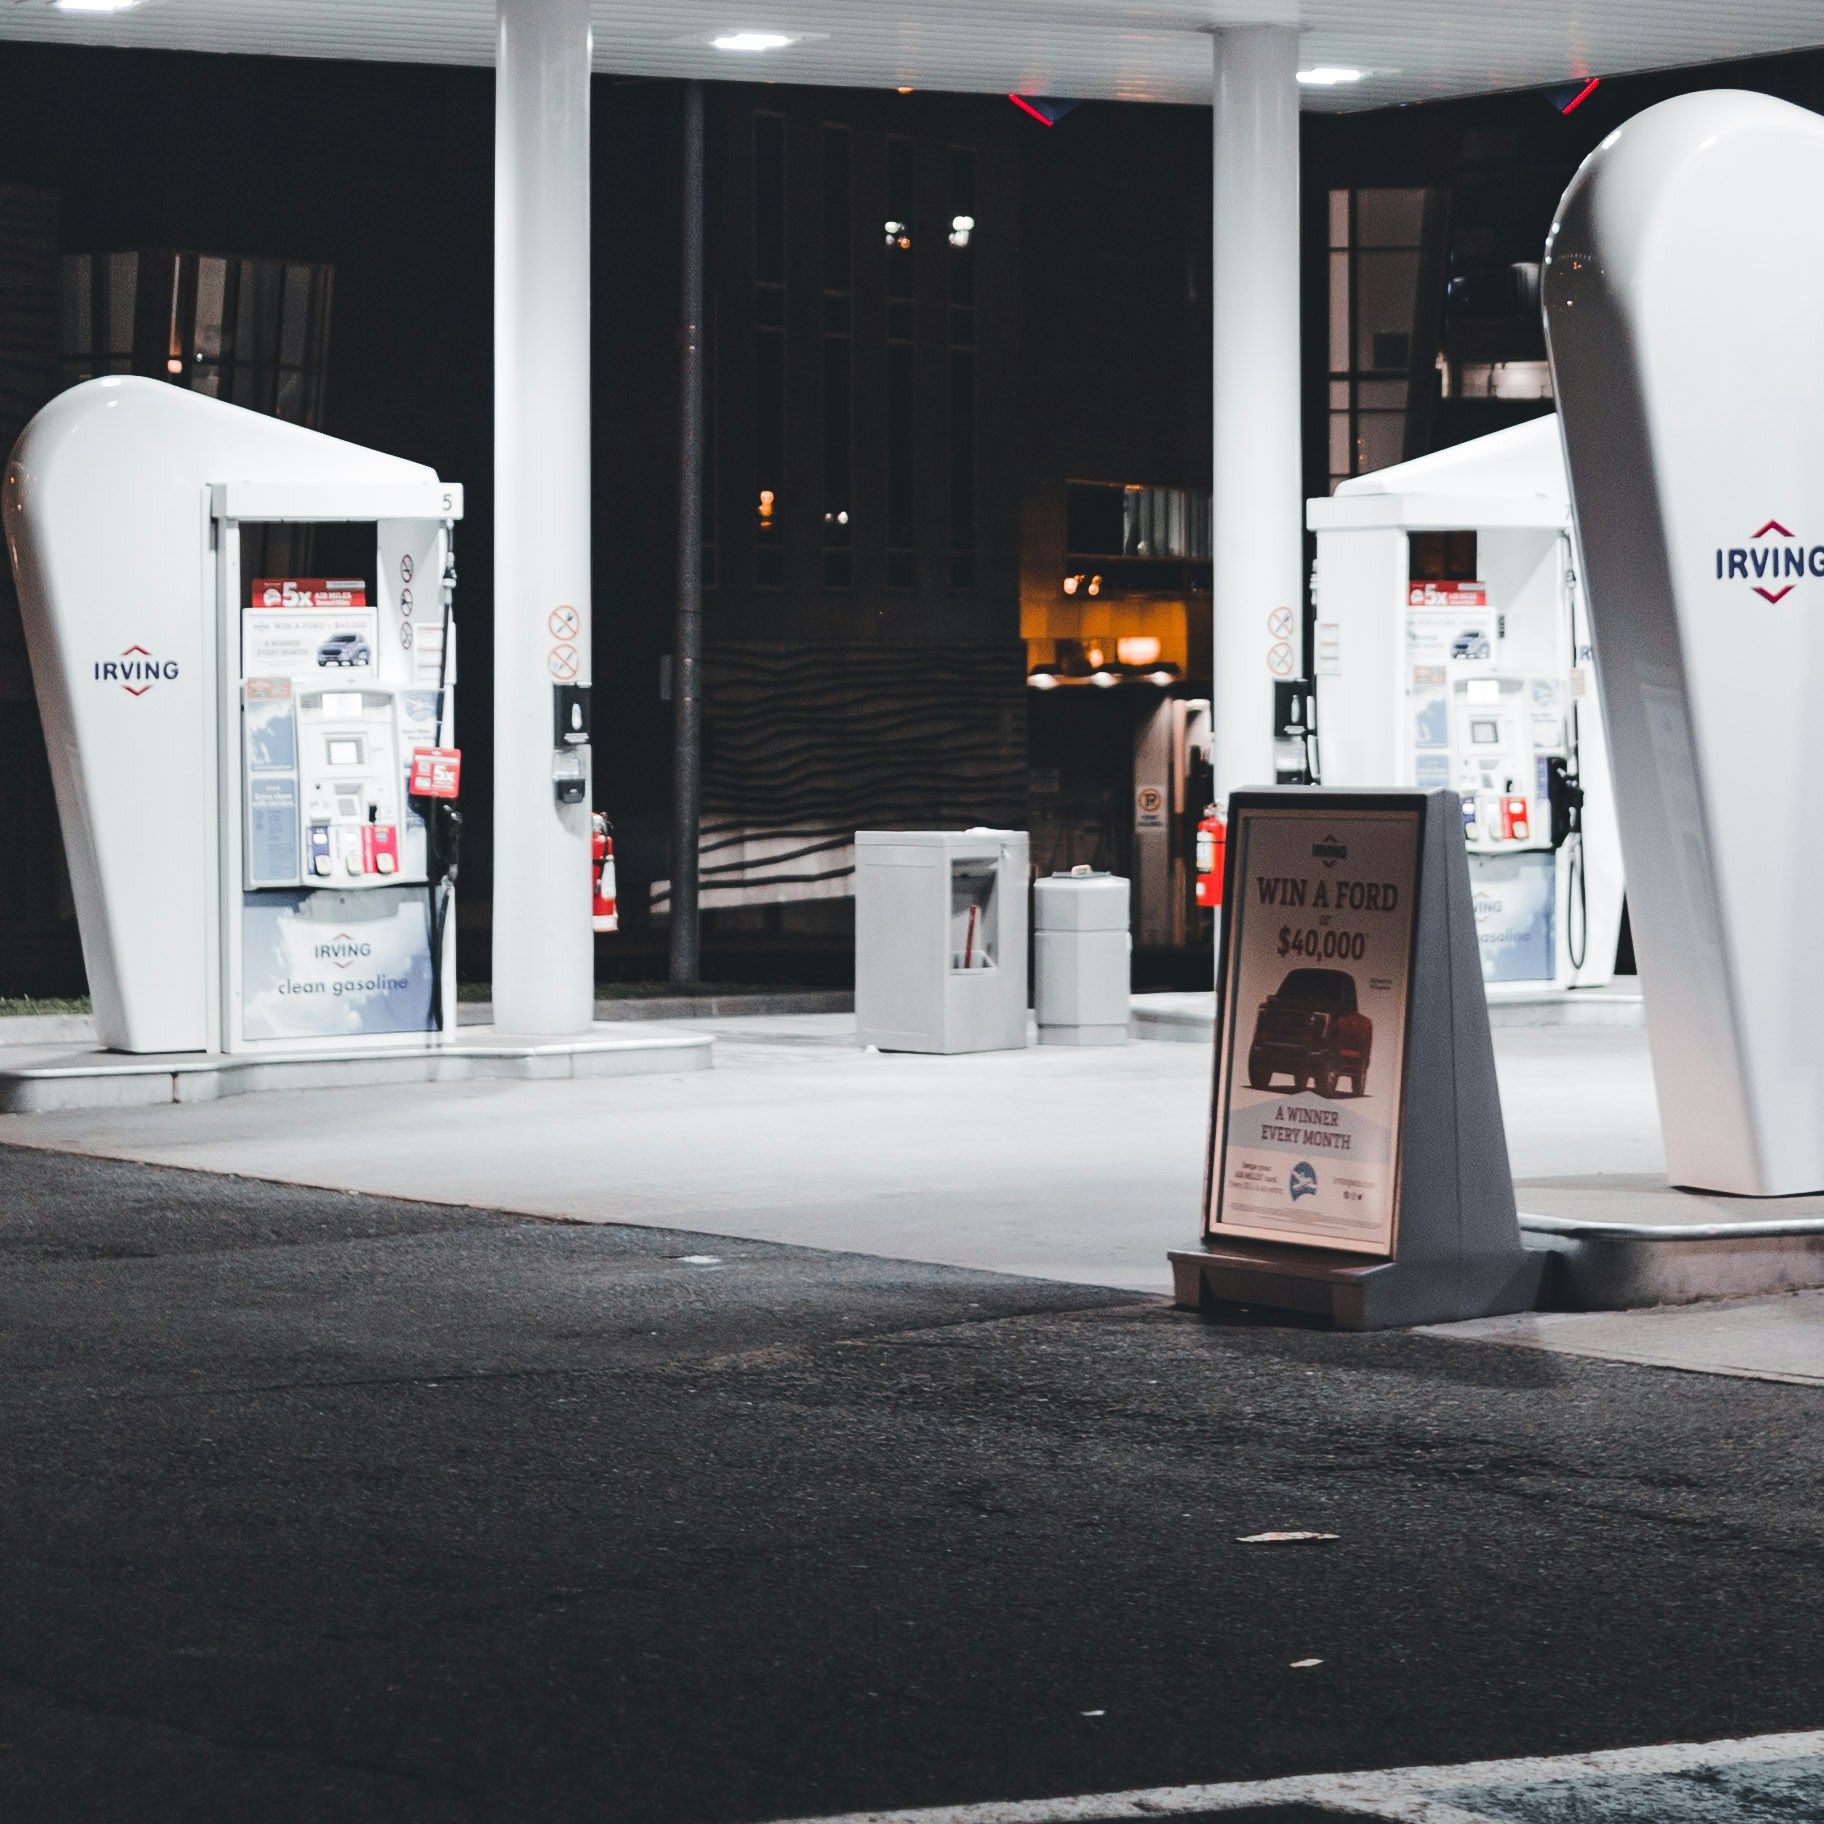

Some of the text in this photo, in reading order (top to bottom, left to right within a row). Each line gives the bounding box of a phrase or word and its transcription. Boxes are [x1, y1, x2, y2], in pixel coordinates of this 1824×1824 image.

[442, 493, 452, 511] 5
[282, 581, 314, 606] 5x
[94, 660, 179, 680] IRVING
[433, 764, 456, 782] 5x
[1312, 843, 1348, 858] IRVING
[1257, 877, 1398, 912] WIN A FORD
[315, 943, 371, 958] IRVING
[278, 974, 409, 996] clean gasoline
[1275, 1106, 1339, 1126] A WINNER
[1261, 1125, 1351, 1150] EVERY MONTH
